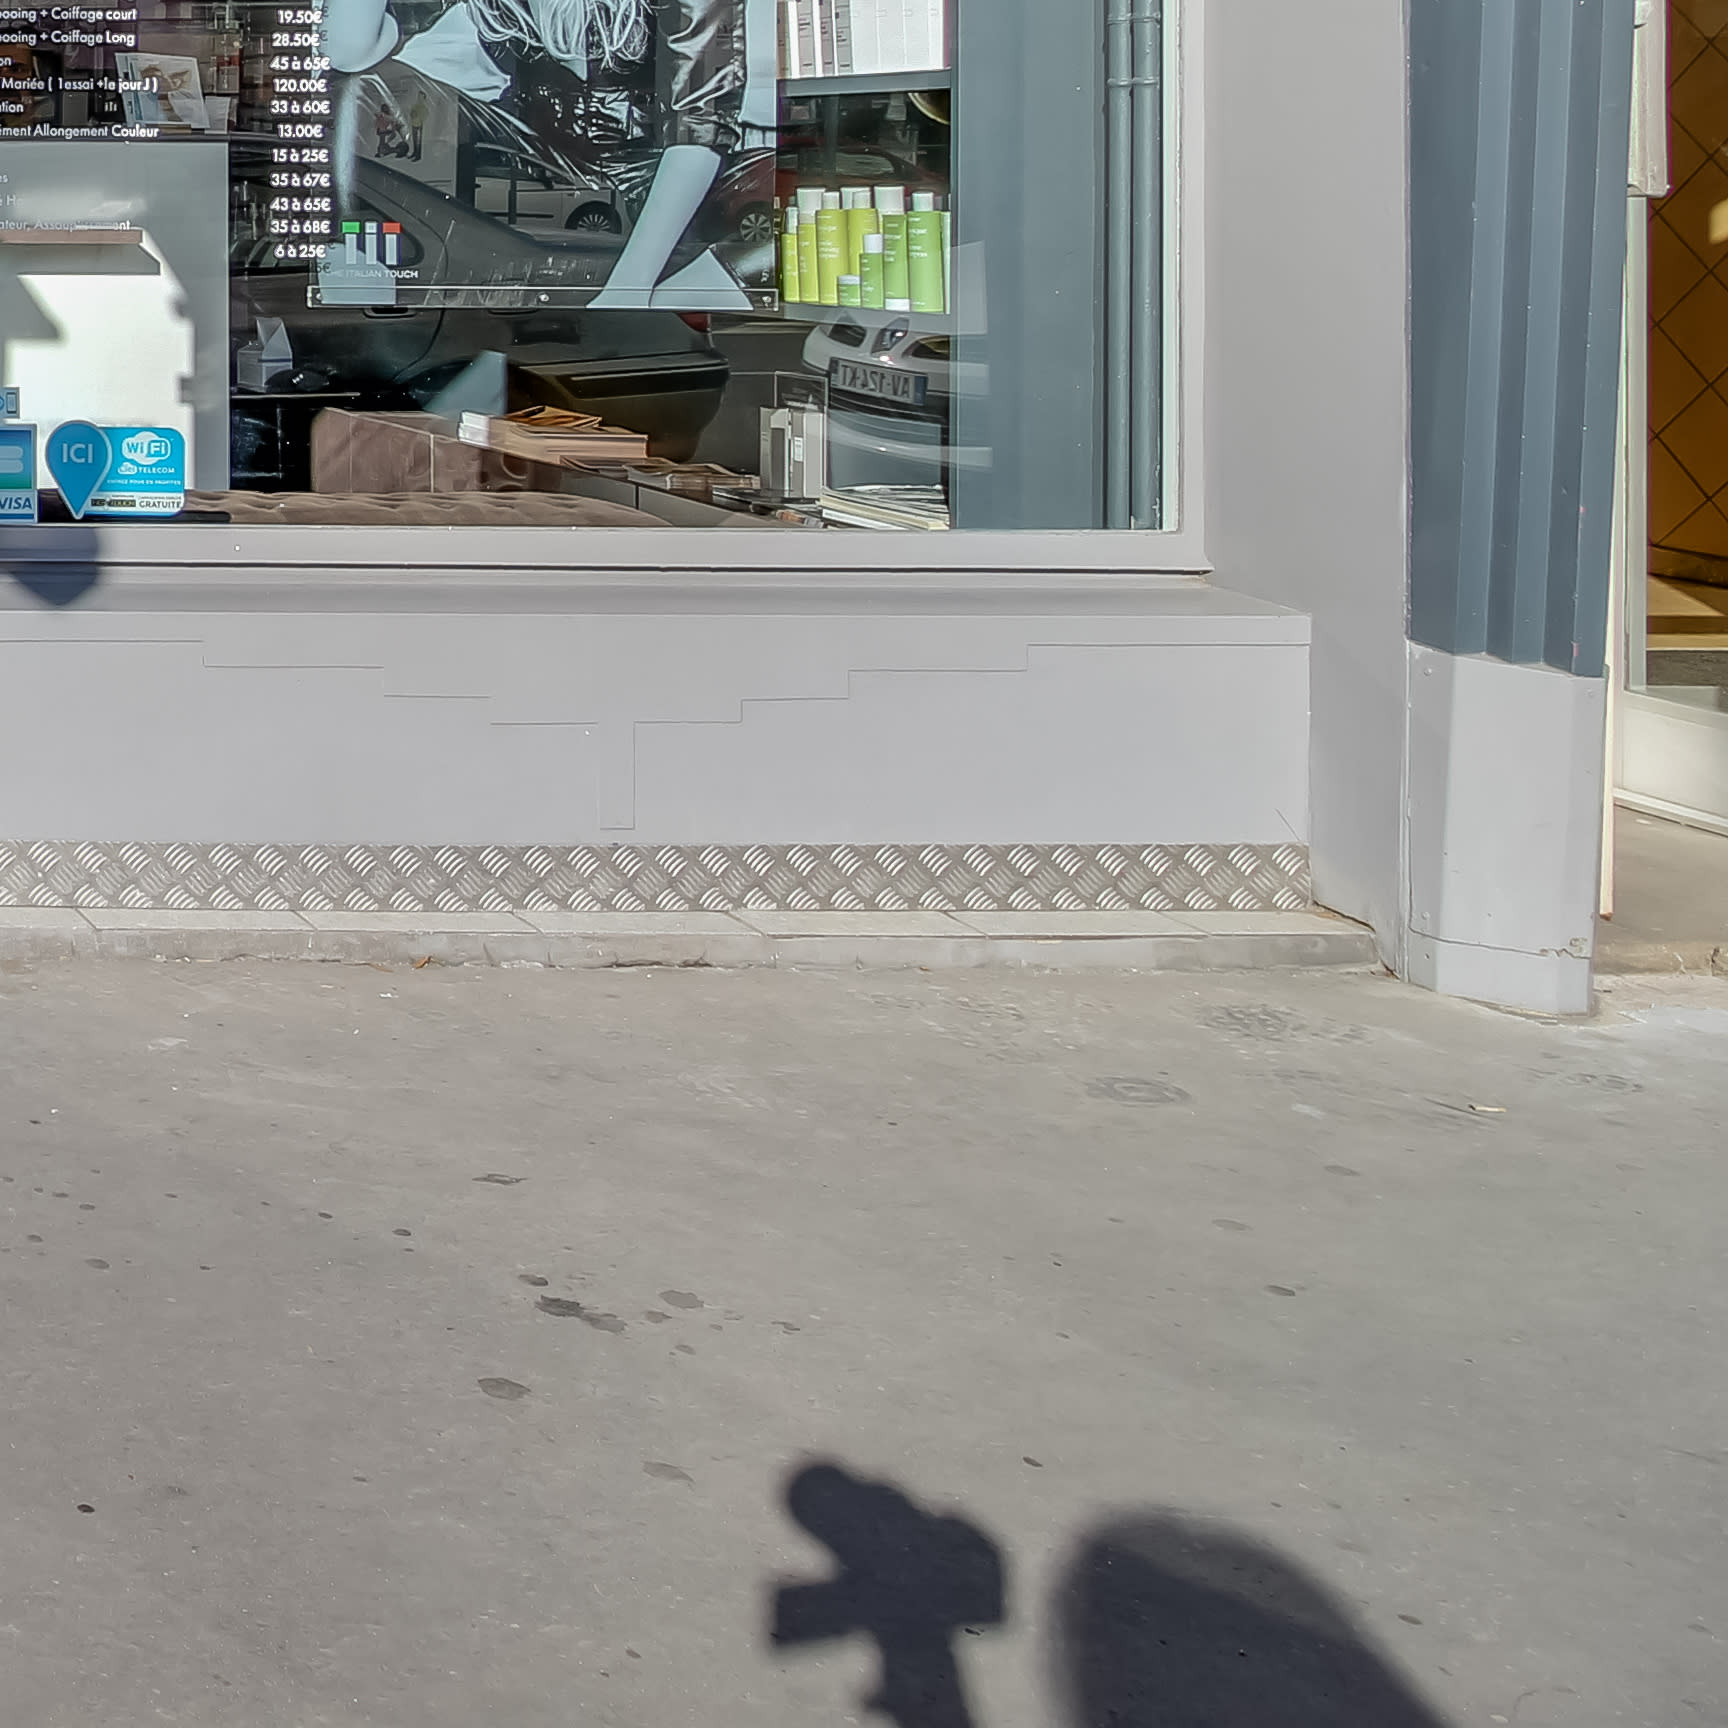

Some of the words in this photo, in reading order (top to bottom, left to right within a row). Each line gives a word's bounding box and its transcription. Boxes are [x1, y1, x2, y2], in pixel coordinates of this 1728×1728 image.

[51, 7, 103, 23] Coiffage
[106, 8, 137, 20] court
[278, 10, 323, 23] 19.50€
[51, 31, 103, 47] Coiffage
[106, 31, 135, 47] Long
[272, 34, 320, 47] 28.50€
[270, 57, 290, 70] 45
[303, 57, 330, 70] 65€
[1, 78, 44, 90] Mariée
[273, 79, 327, 92] 120.00€
[271, 101, 289, 114] 33
[303, 101, 330, 114] 60€
[33, 125, 108, 139] Allongement
[111, 125, 160, 138] Couleur
[278, 125, 323, 138] 13.00€
[272, 149, 287, 162] 15
[301, 149, 328, 162] 25€
[270, 173, 290, 186] 35
[303, 173, 330, 186] 67€
[270, 198, 290, 211] 43
[303, 198, 330, 211] 65€
[270, 220, 290, 234] 35
[303, 220, 330, 234] 68€
[275, 245, 285, 258] 6
[299, 245, 326, 258] 25€
[383, 270, 419, 278] TOUCH
[62, 442, 93, 463] ICI
